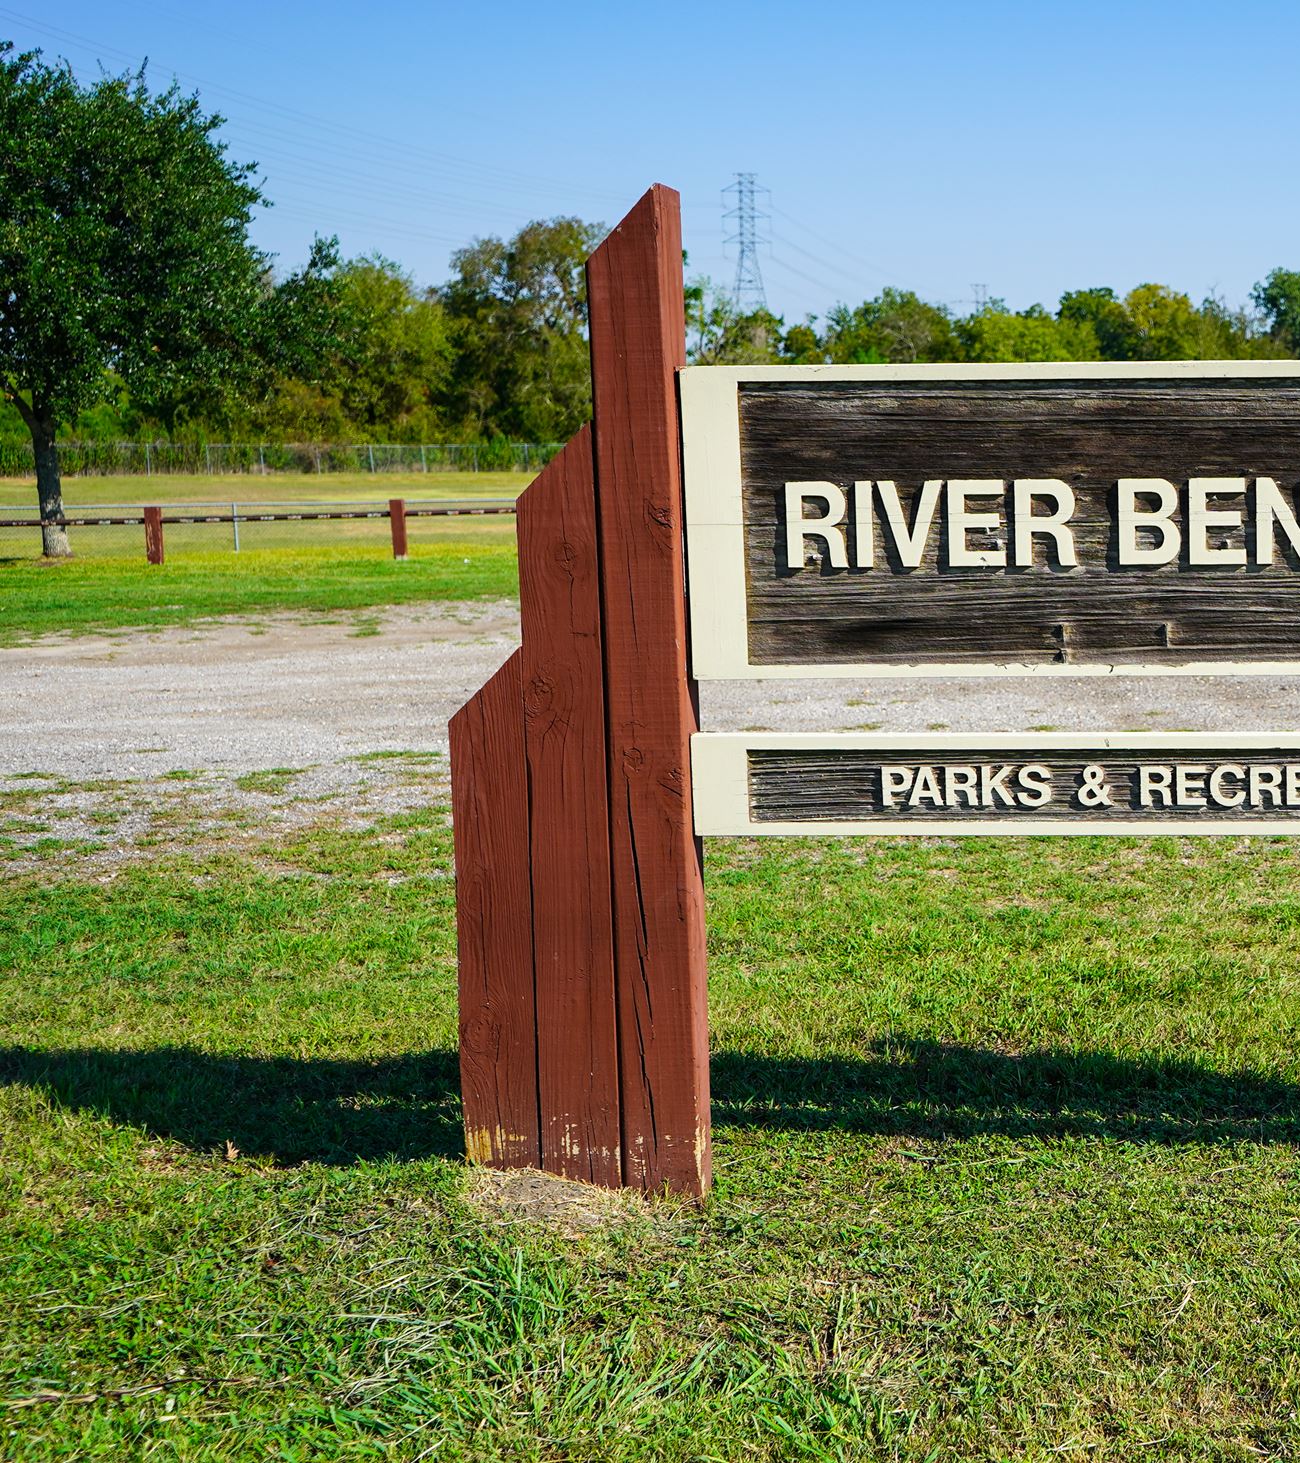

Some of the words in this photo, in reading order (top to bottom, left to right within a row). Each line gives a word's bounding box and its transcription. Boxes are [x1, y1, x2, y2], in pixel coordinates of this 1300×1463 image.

[784, 479, 1078, 568] RIVER
[880, 765, 1052, 808] PARKS
[1077, 765, 1113, 808] &
